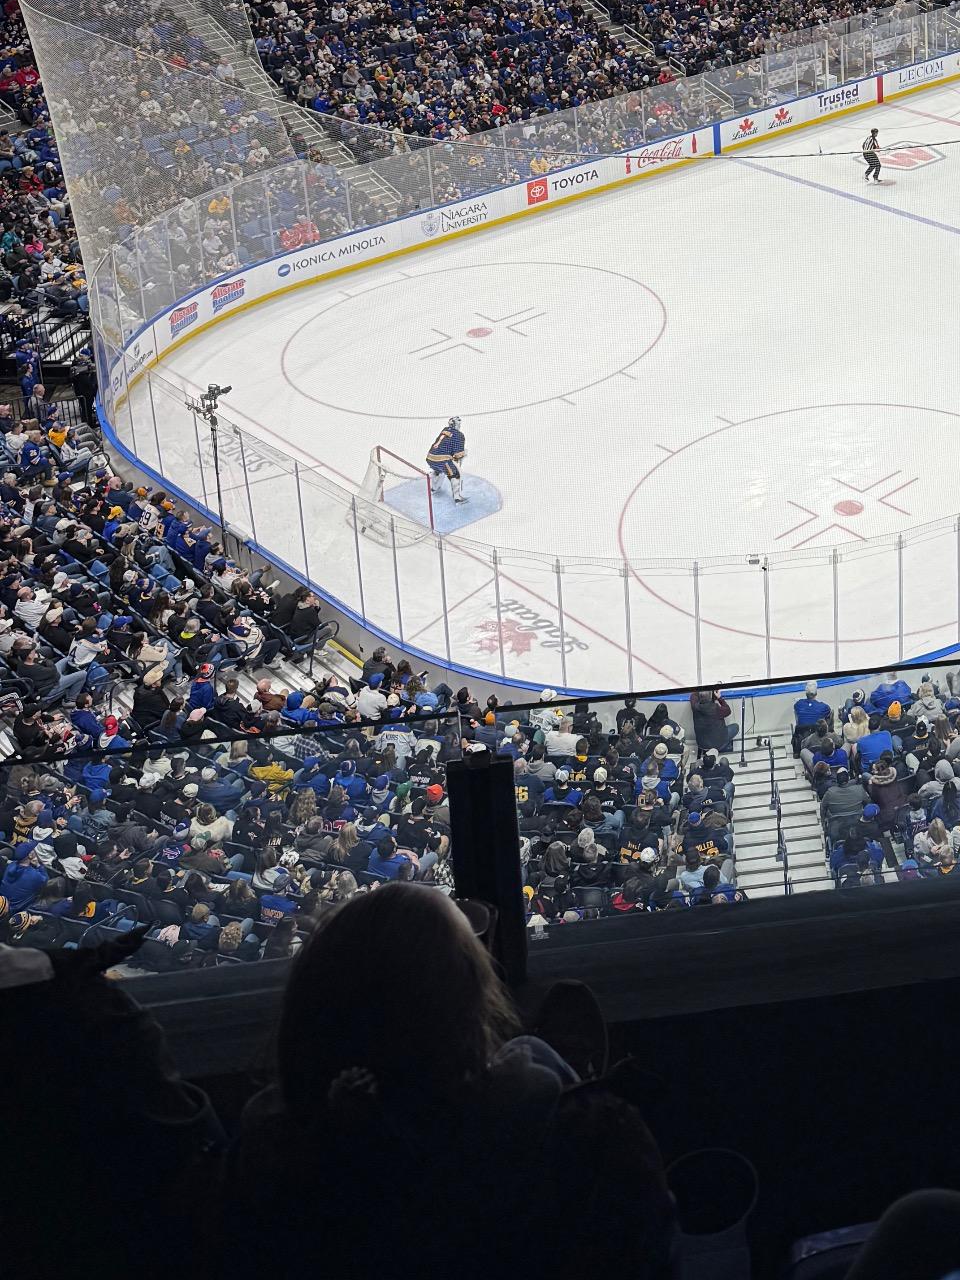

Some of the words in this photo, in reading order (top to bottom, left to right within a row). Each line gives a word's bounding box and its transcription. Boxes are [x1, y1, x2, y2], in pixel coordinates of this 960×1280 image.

[899, 60, 944, 83] LECOM
[817, 85, 859, 107] Trusted
[732, 127, 758, 140] Labatt
[768, 116, 793, 130] Labatt
[552, 170, 598, 191] TOYOTA
[441, 202, 488, 222] NIAGARA
[441, 212, 488, 233] UNIVERSITY
[292, 252, 336, 272] KONICA
[338, 235, 386, 258] MINOLTA
[212, 280, 245, 300] Allstate
[213, 288, 244, 308] Roofing
[170, 303, 198, 325] Allstate
[171, 312, 198, 333] Roofing
[487, 599, 589, 654] Labatt
